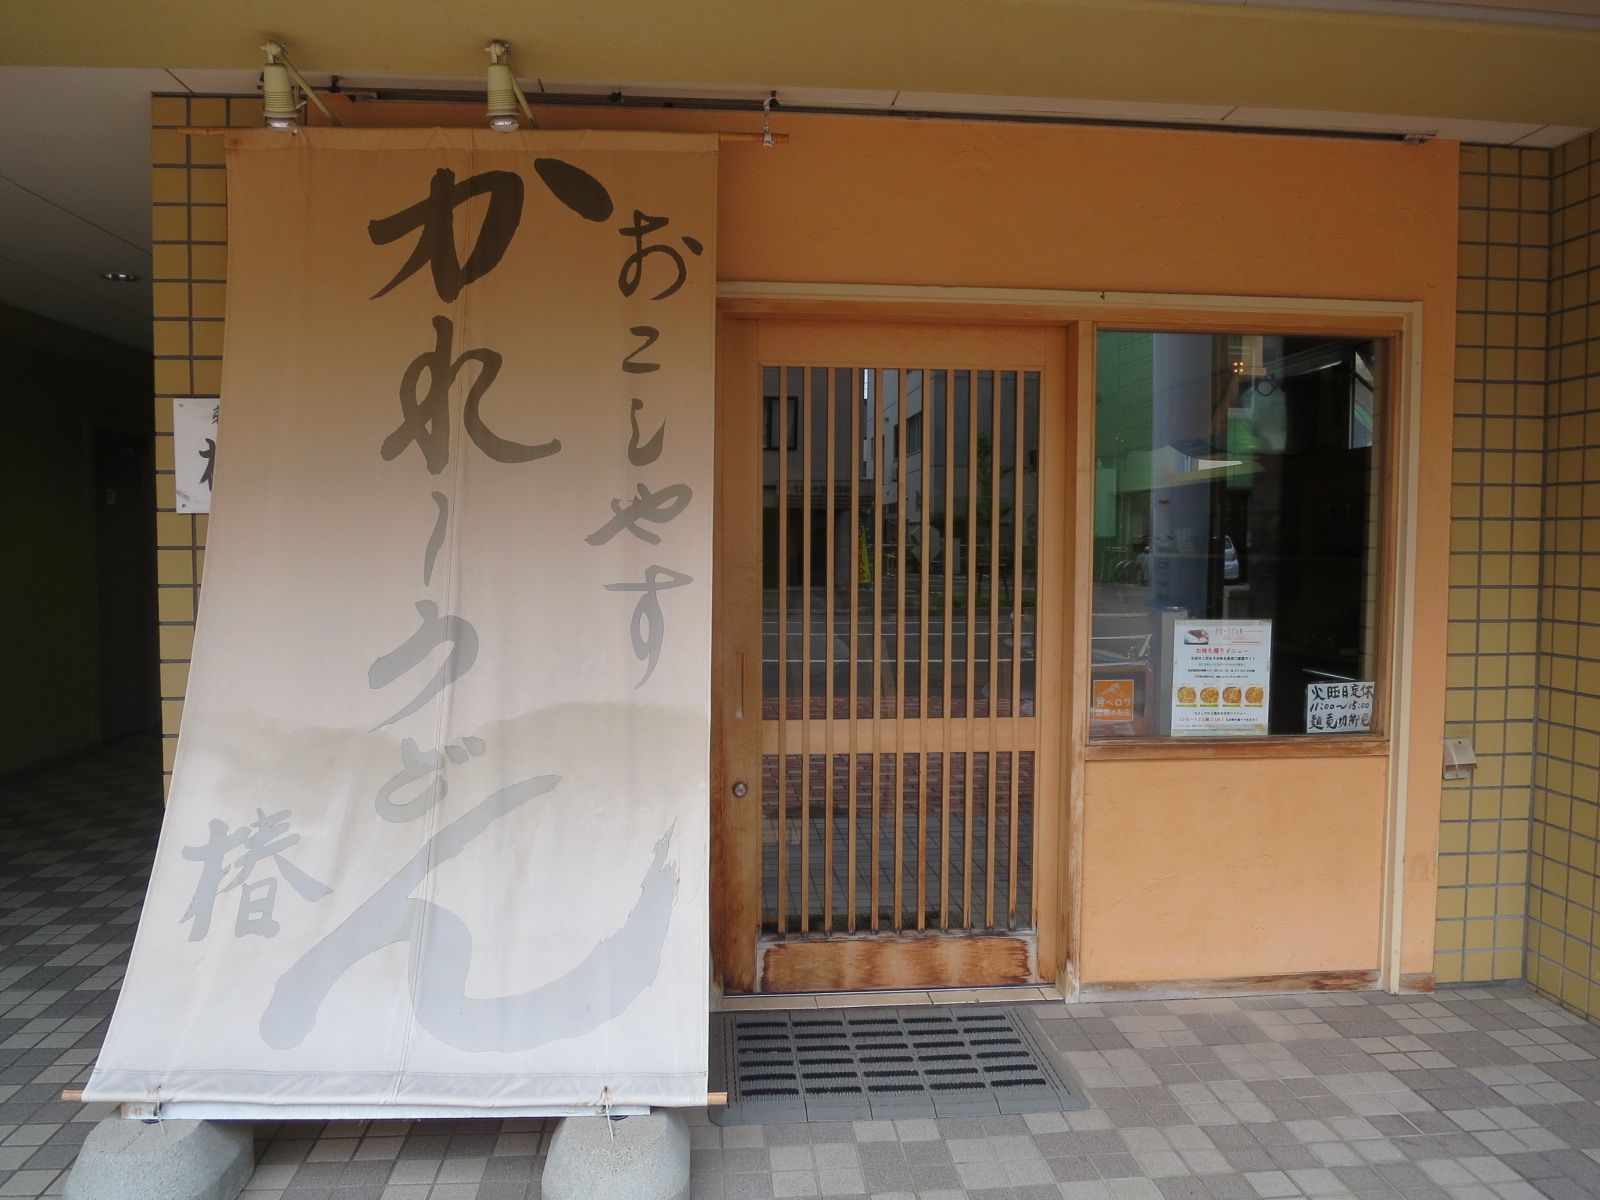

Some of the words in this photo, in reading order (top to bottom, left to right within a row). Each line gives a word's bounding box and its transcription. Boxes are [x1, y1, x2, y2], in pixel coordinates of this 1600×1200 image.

[584, 210, 703, 690] おこしやす
[259, 158, 679, 1053] かれーうどん
[1096, 696, 1131, 708] 食べログ
[179, 807, 332, 942] 椿
